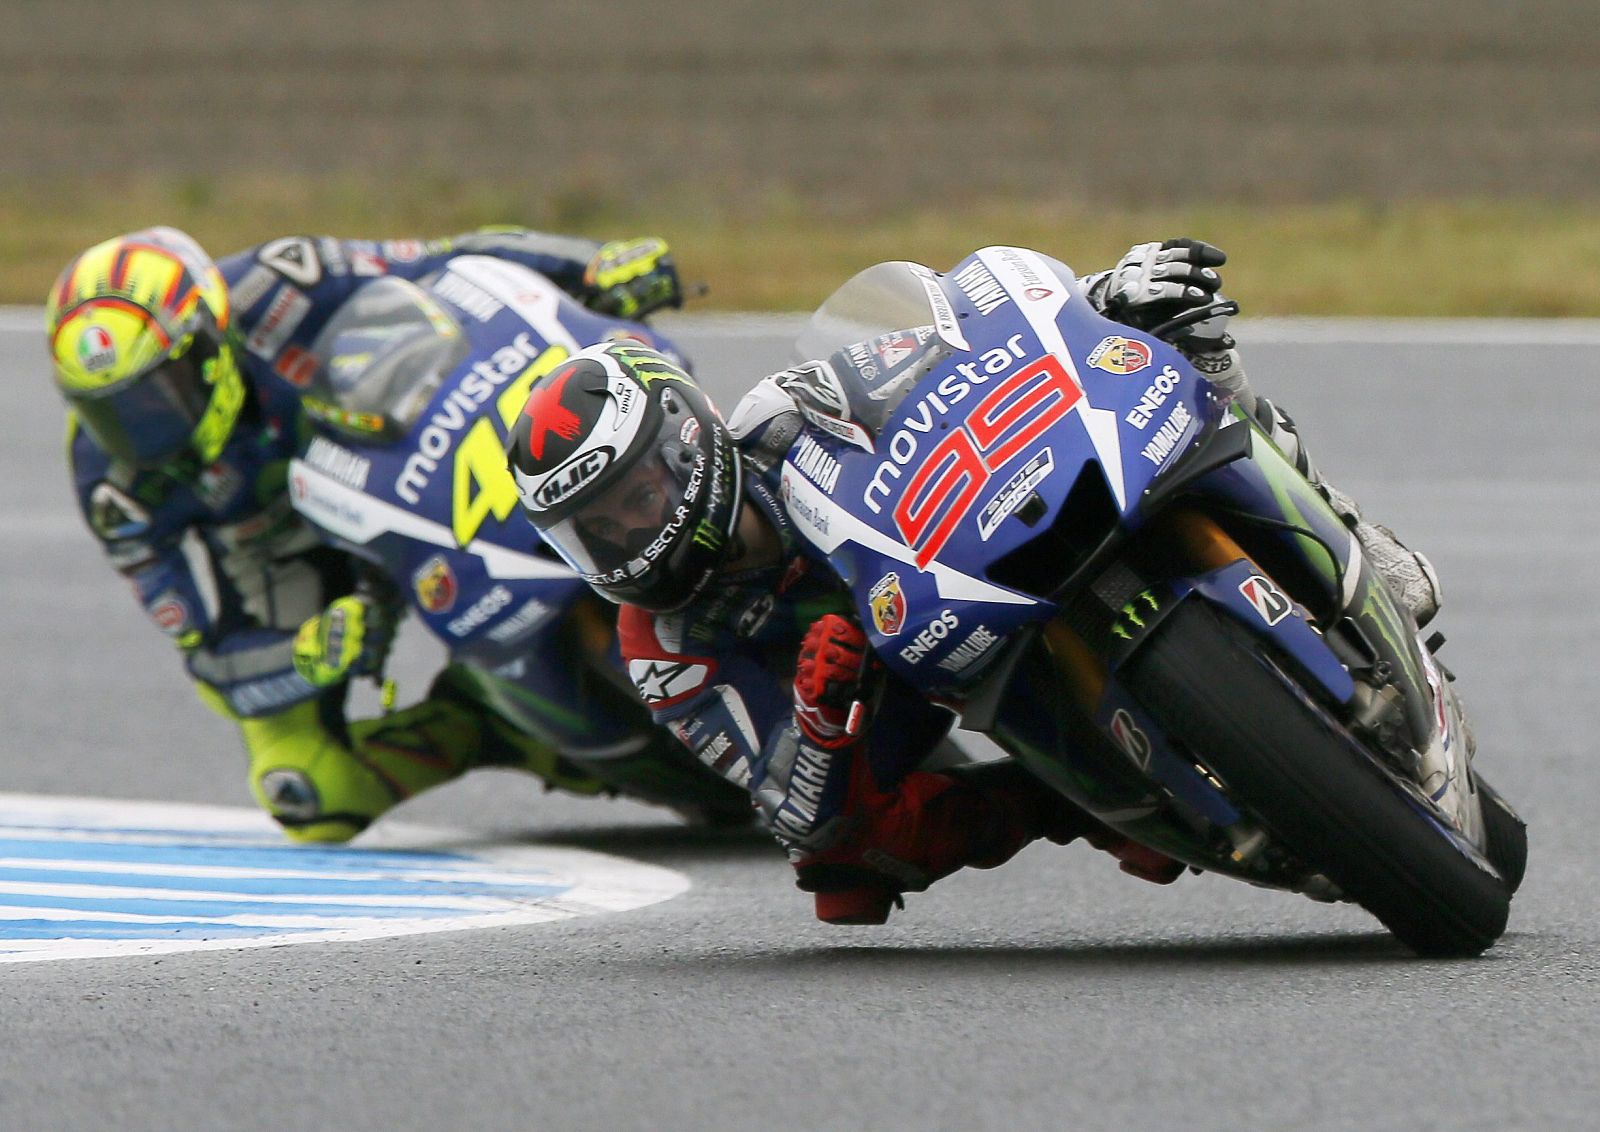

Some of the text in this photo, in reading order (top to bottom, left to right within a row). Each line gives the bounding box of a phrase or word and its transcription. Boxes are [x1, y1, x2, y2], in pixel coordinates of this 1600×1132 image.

[953, 259, 1011, 317] YAMAHA
[394, 331, 540, 505] movistar
[620, 388, 633, 414] RPHA
[863, 333, 1027, 514] movistar
[1125, 364, 1181, 430] ENEOS
[891, 352, 1087, 573] 99
[1140, 400, 1192, 466] YAMALUBE
[542, 451, 602, 505] HJC
[793, 435, 842, 495] YAMAHA
[987, 459, 1040, 515] BLUE
[991, 471, 1041, 527] CORE
[899, 608, 959, 665] ENEOS
[936, 624, 999, 673] YAMALUBE
[769, 743, 833, 840] YAMAHA
